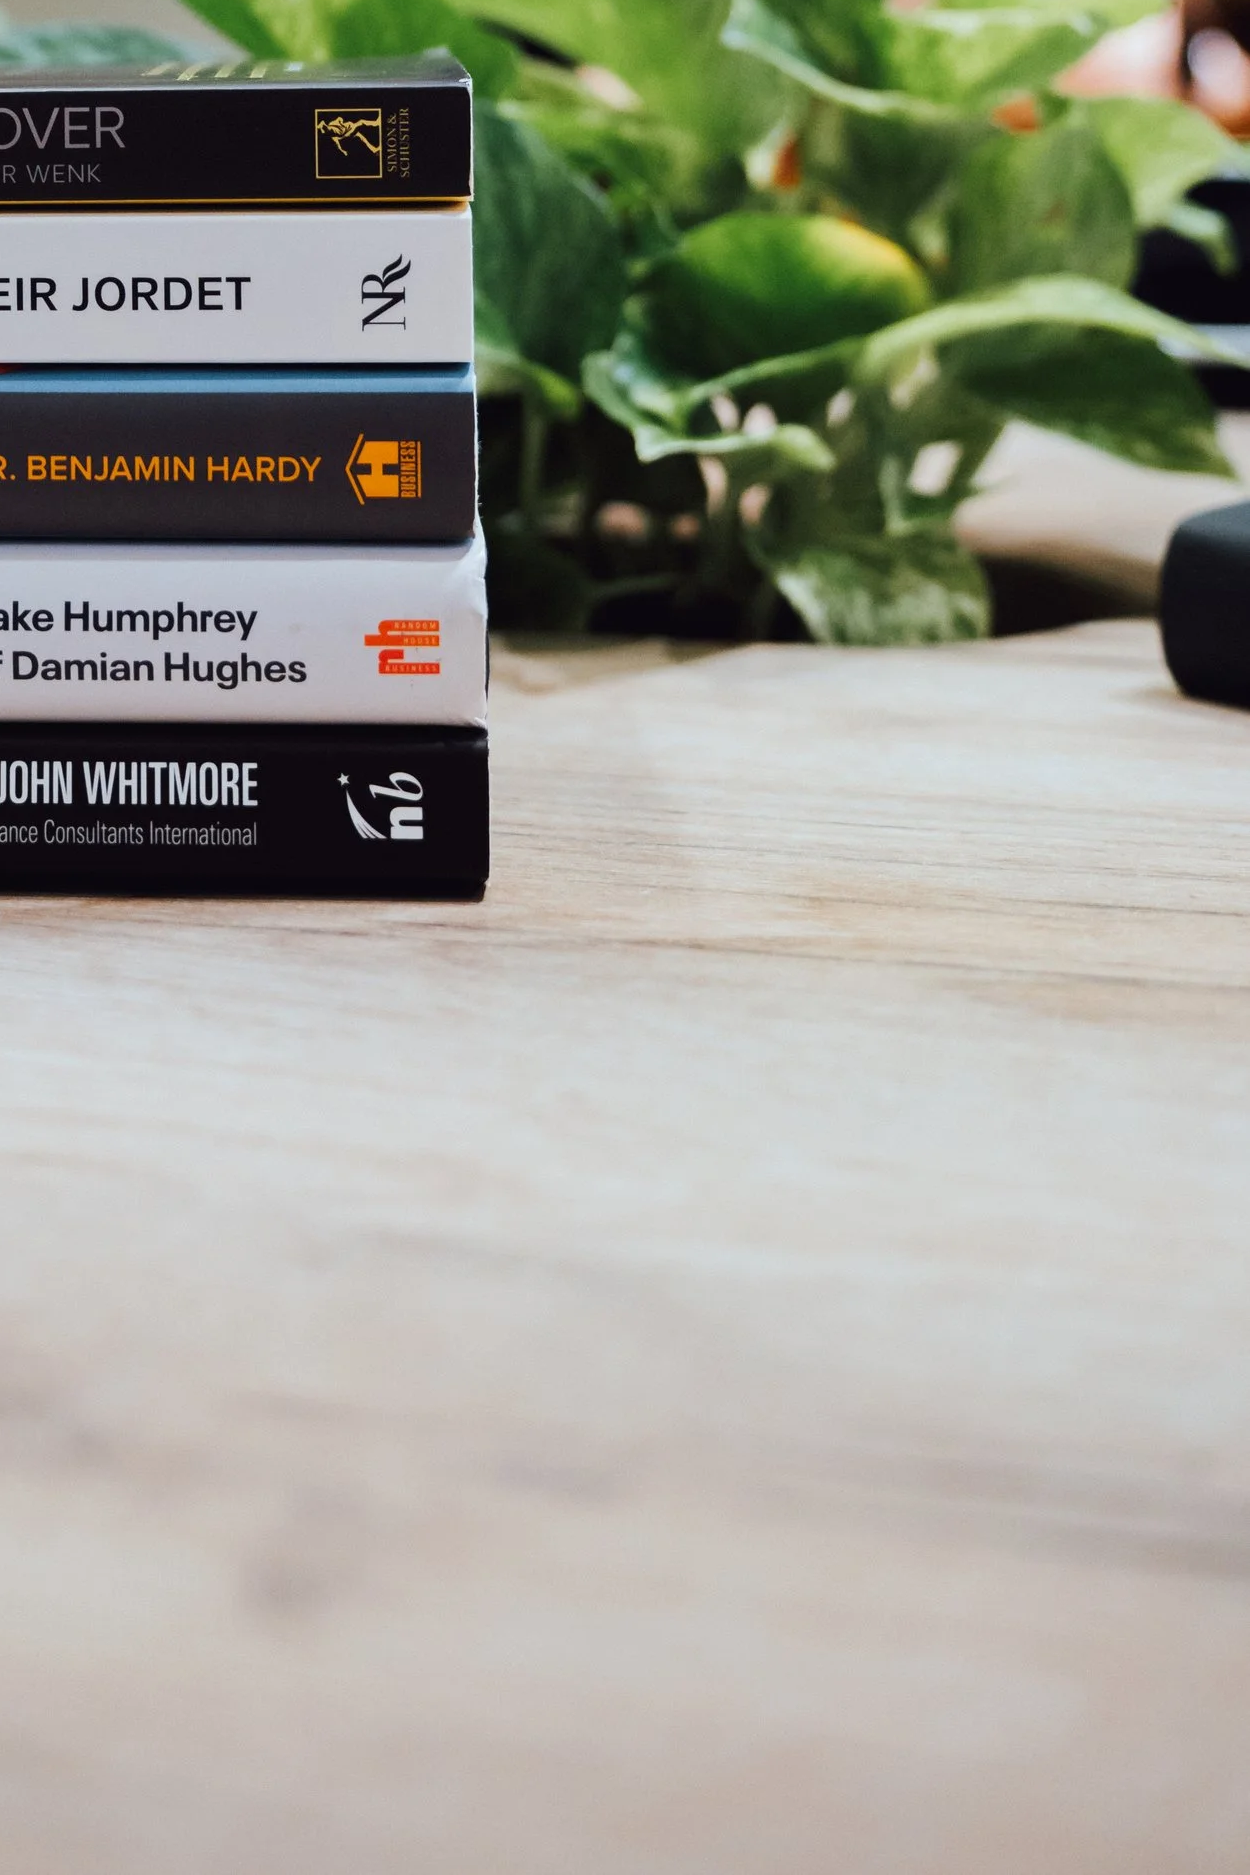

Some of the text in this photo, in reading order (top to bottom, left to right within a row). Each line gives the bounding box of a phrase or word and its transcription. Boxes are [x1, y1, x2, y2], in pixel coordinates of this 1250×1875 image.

[387, 128, 397, 172] SIMON
[399, 108, 410, 178] SCHUSTER
[26, 164, 101, 183] WENK
[73, 277, 251, 311] JORDET
[28, 456, 194, 481] BENJAMIN
[208, 457, 321, 481] HARDY
[400, 441, 416, 498] BUSINESS
[65, 601, 257, 641] Humphrey
[394, 621, 437, 630] RANDOM
[13, 651, 154, 681] Damian
[165, 652, 306, 690] Hughes
[385, 664, 438, 672] BUSINESS
[83, 762, 258, 806] WHITMORE
[44, 819, 143, 844] Consultants
[150, 821, 256, 845] International
